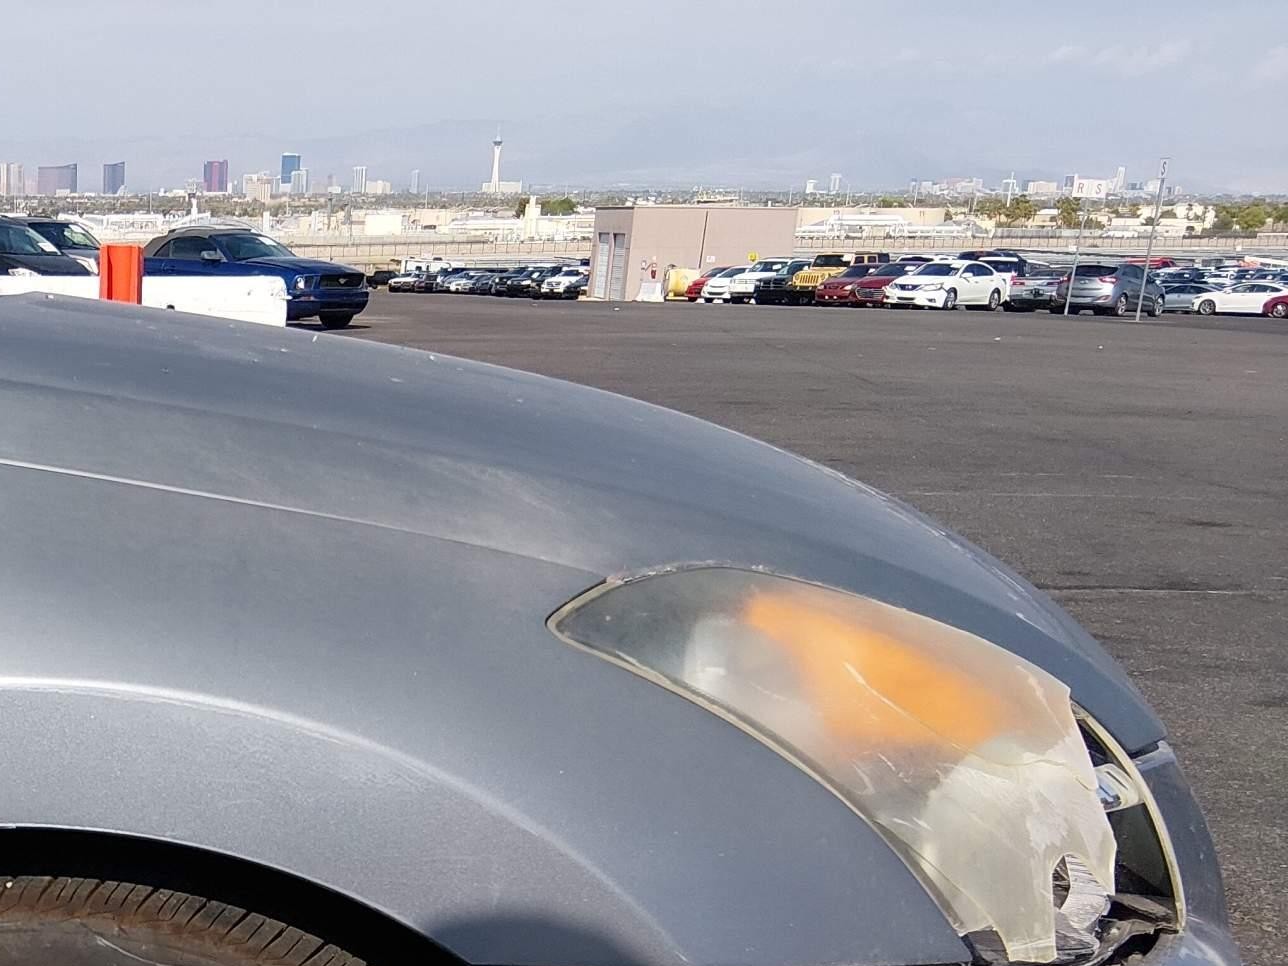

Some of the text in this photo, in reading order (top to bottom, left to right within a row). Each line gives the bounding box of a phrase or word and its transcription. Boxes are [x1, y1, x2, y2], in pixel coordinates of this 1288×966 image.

[1160, 161, 1167, 177] S
[1077, 183, 1103, 192] R S
